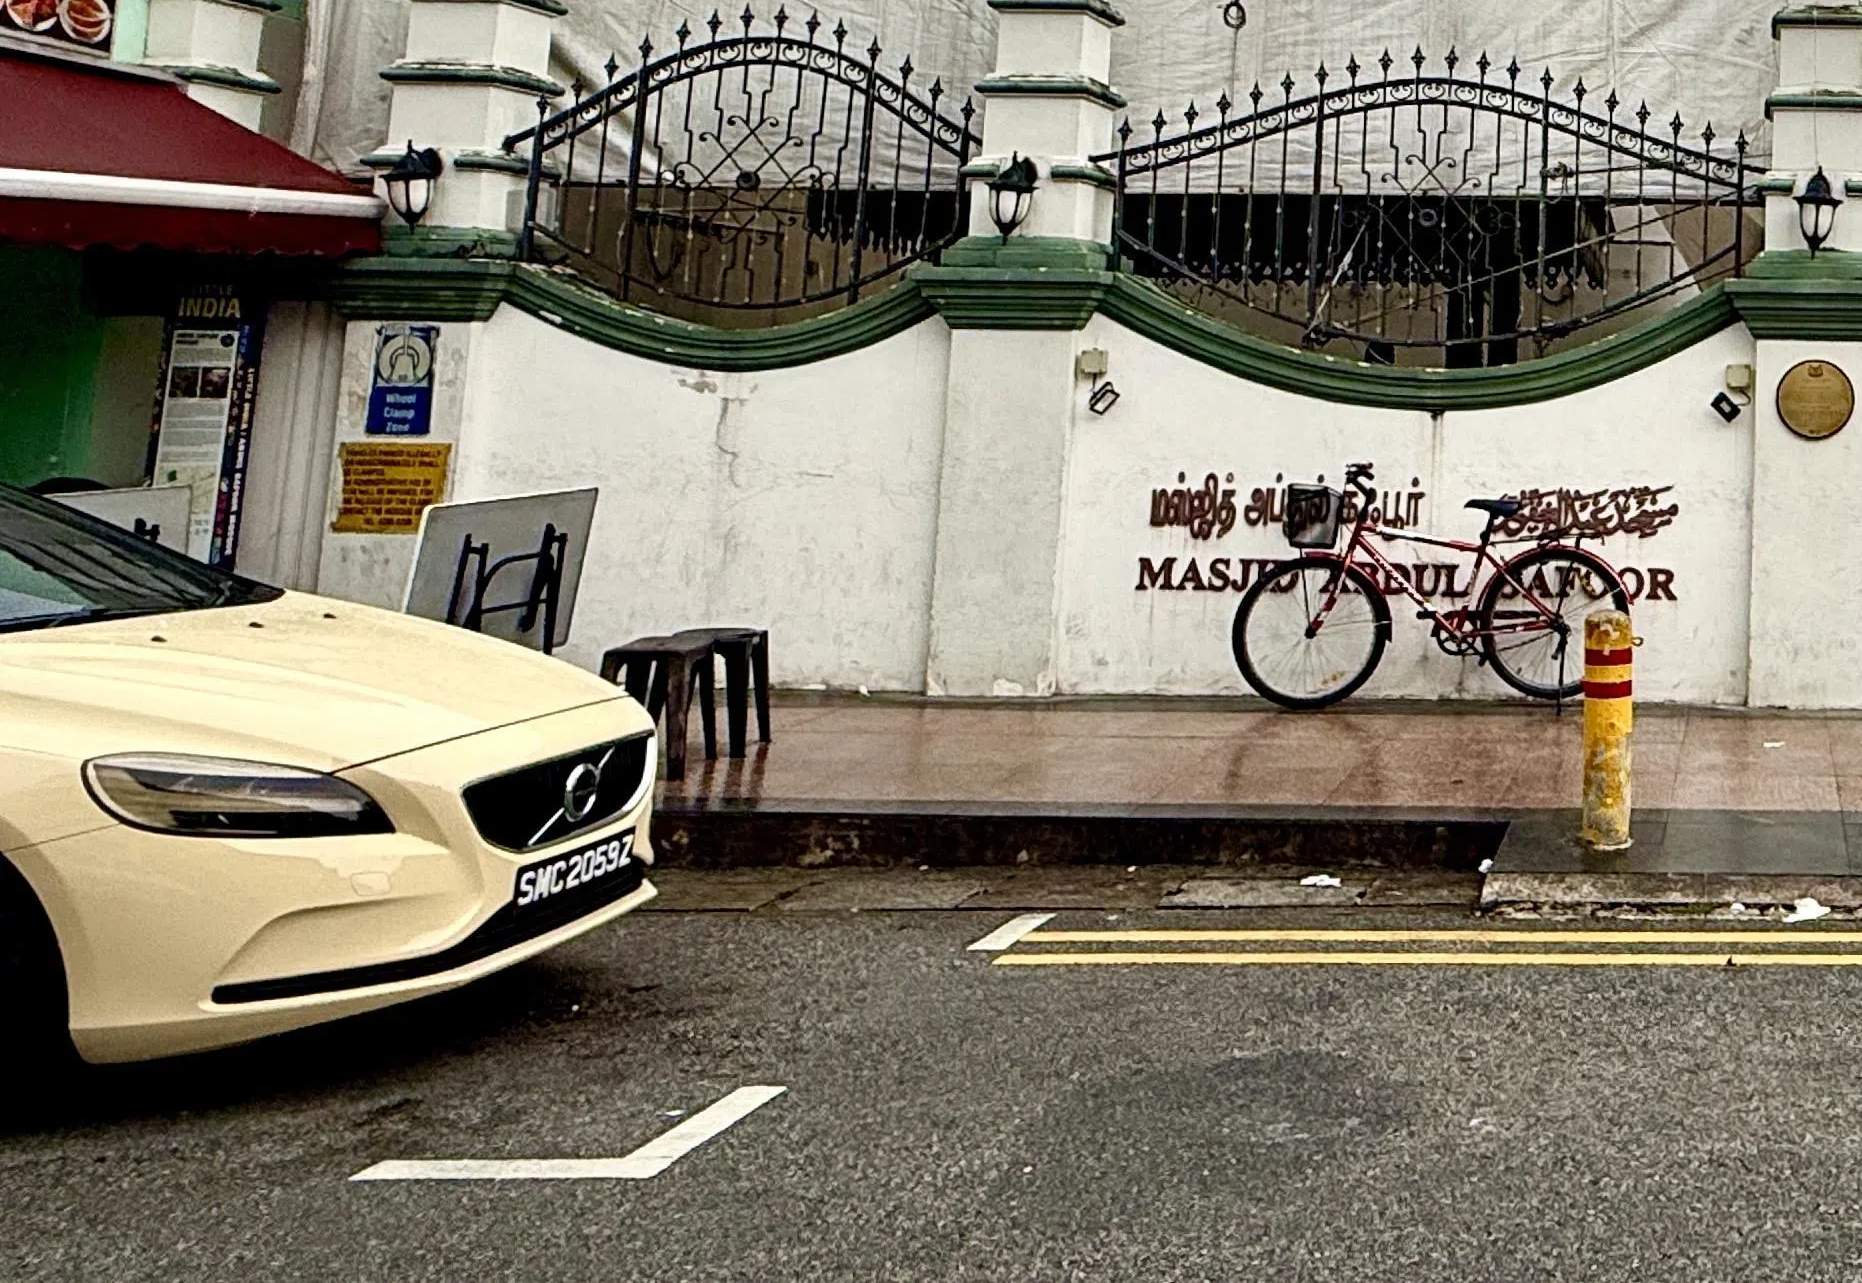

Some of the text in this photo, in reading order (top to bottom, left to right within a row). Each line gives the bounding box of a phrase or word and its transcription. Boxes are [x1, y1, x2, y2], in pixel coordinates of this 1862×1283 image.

[178, 297, 241, 318] INDIA
[386, 393, 417, 404] Wheel
[384, 407, 416, 420] Clamp
[517, 834, 634, 907] SMC2059Z
